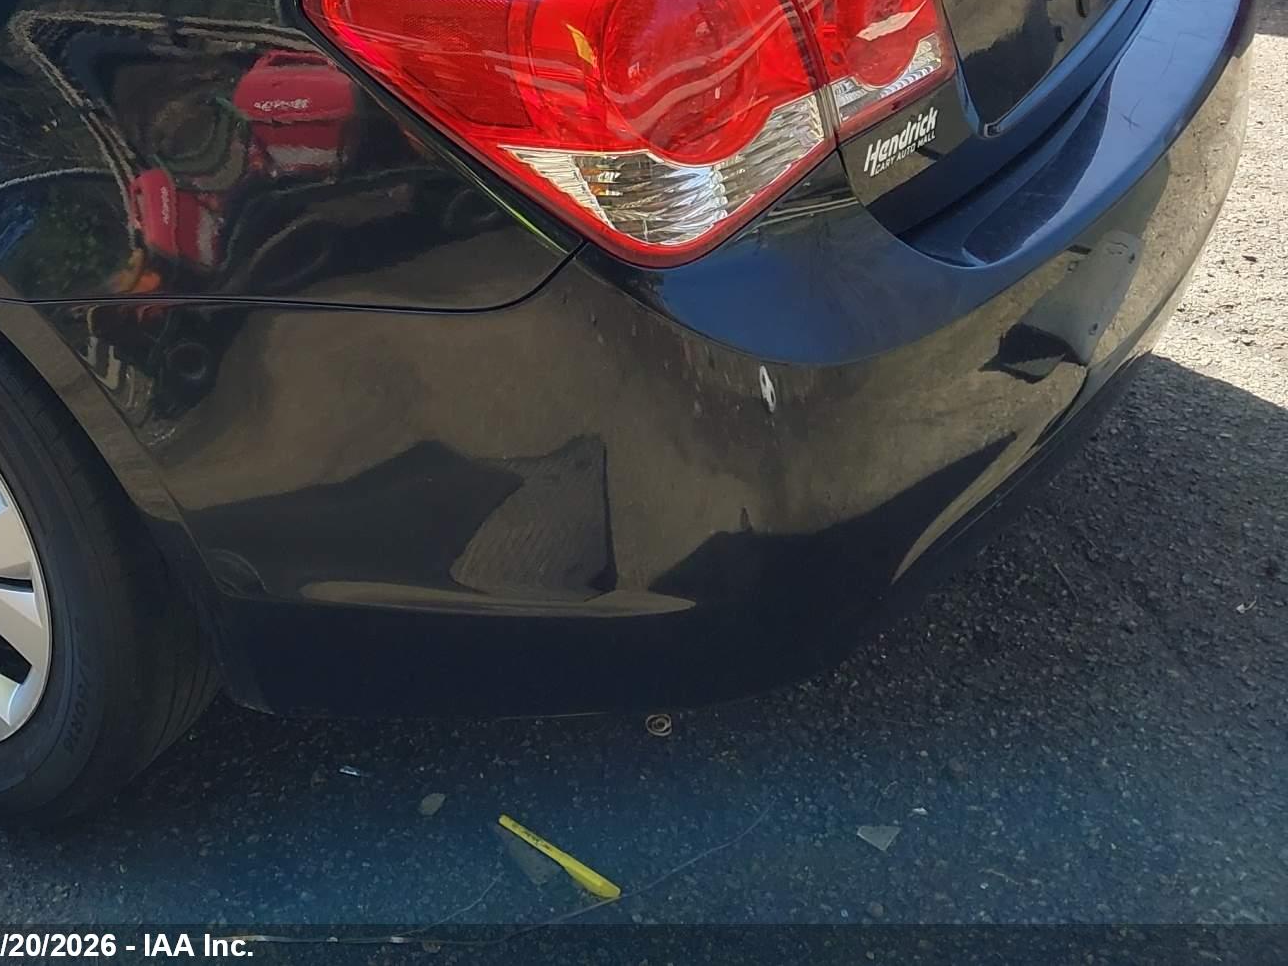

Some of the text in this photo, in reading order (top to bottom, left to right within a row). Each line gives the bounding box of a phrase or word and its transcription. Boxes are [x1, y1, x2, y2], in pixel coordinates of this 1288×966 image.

[863, 106, 939, 177] Hendrick
[875, 130, 936, 174] CARY AUTO MALL
